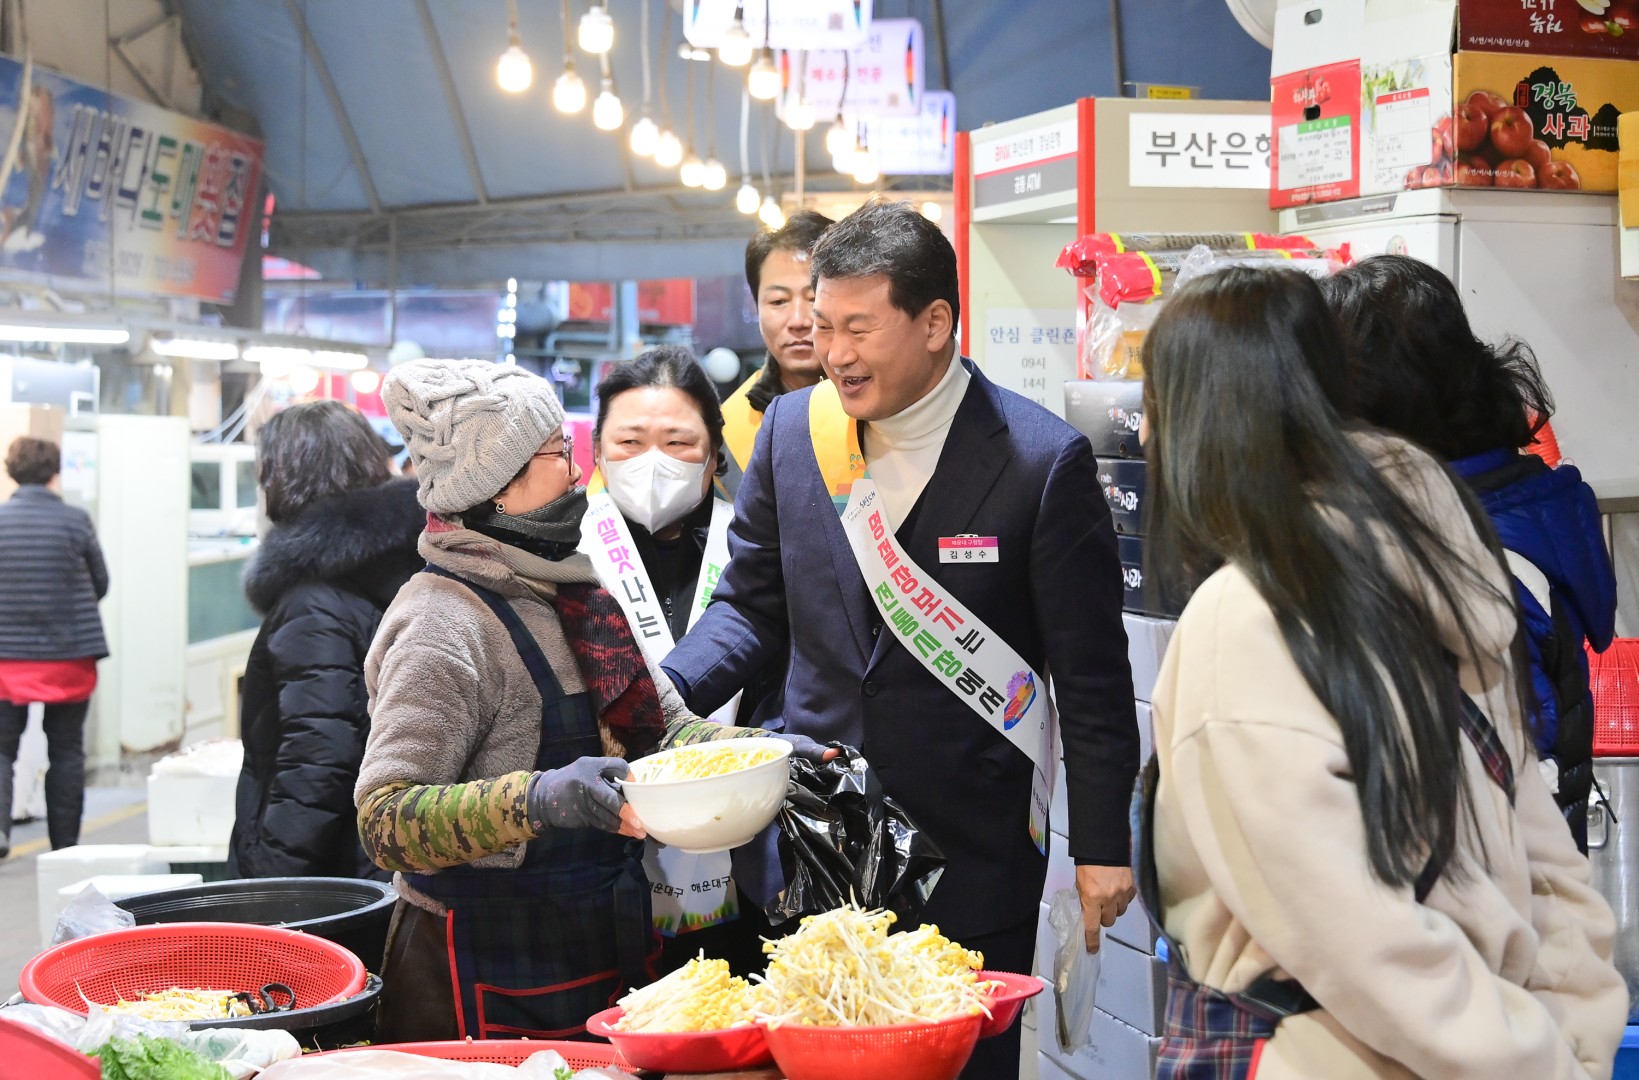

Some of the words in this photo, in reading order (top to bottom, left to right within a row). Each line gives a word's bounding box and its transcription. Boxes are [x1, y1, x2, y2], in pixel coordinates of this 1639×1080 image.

[1531, 81, 1577, 112] 경북
[1541, 113, 1591, 141] 사과
[1026, 171, 1041, 192] ATM
[990, 327, 1020, 344] 안심
[1021, 357, 1046, 369] 09시
[1023, 378, 1046, 390] 14시
[875, 581, 1006, 716] 전통시장에서
[691, 875, 731, 894] 해운대구
